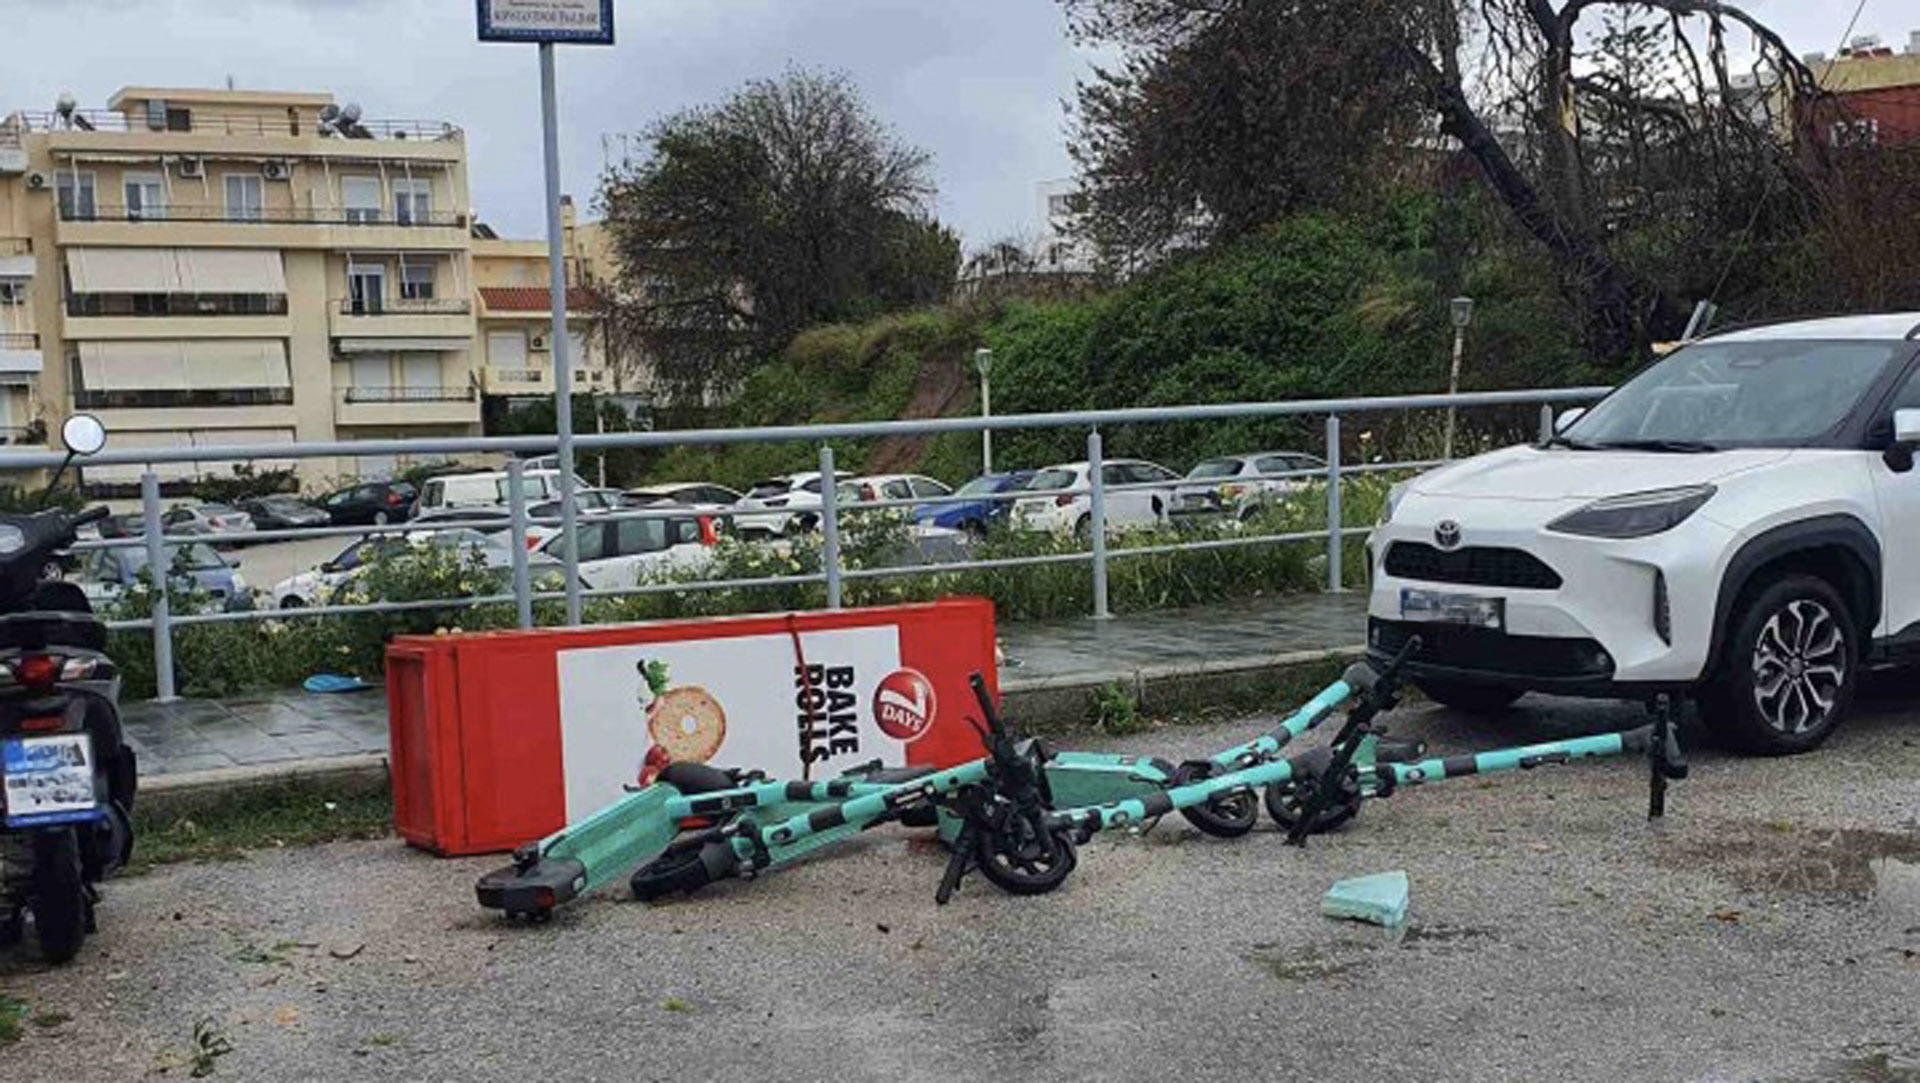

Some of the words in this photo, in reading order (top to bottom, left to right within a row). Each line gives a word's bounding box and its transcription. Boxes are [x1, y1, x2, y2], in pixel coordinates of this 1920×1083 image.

[795, 665, 830, 764] ROLLS
[826, 666, 859, 755] BAKE
[880, 678, 927, 719] 7
[882, 704, 924, 731] DAYS
